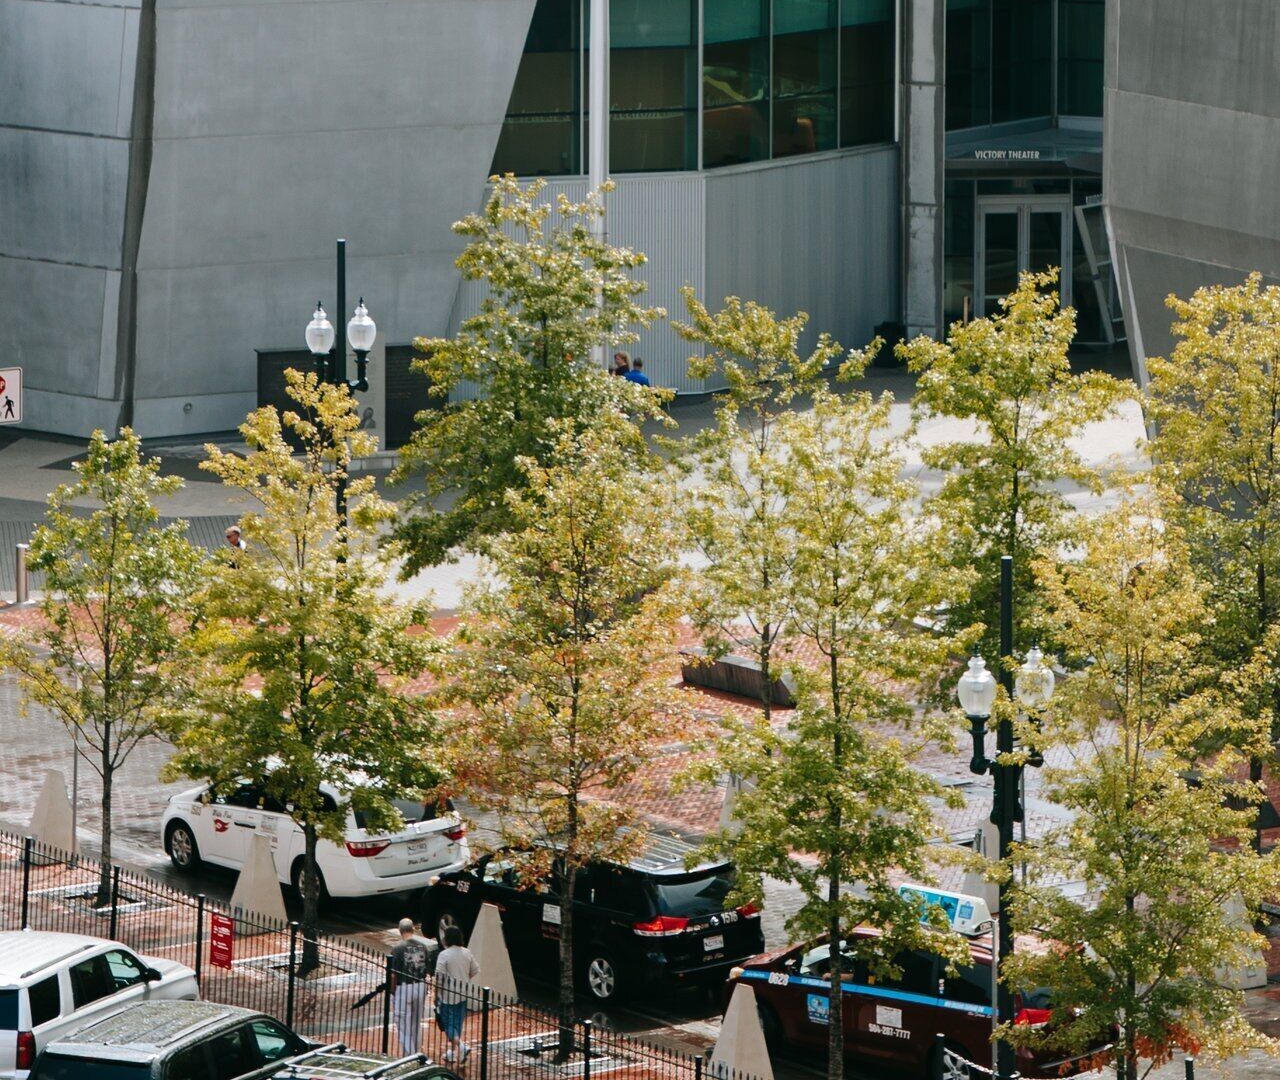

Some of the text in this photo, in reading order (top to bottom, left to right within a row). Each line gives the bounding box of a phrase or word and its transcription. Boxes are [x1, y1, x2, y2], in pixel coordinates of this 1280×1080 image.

[974, 150, 1040, 160] VICTORY THEATER
[721, 910, 738, 924] 1516
